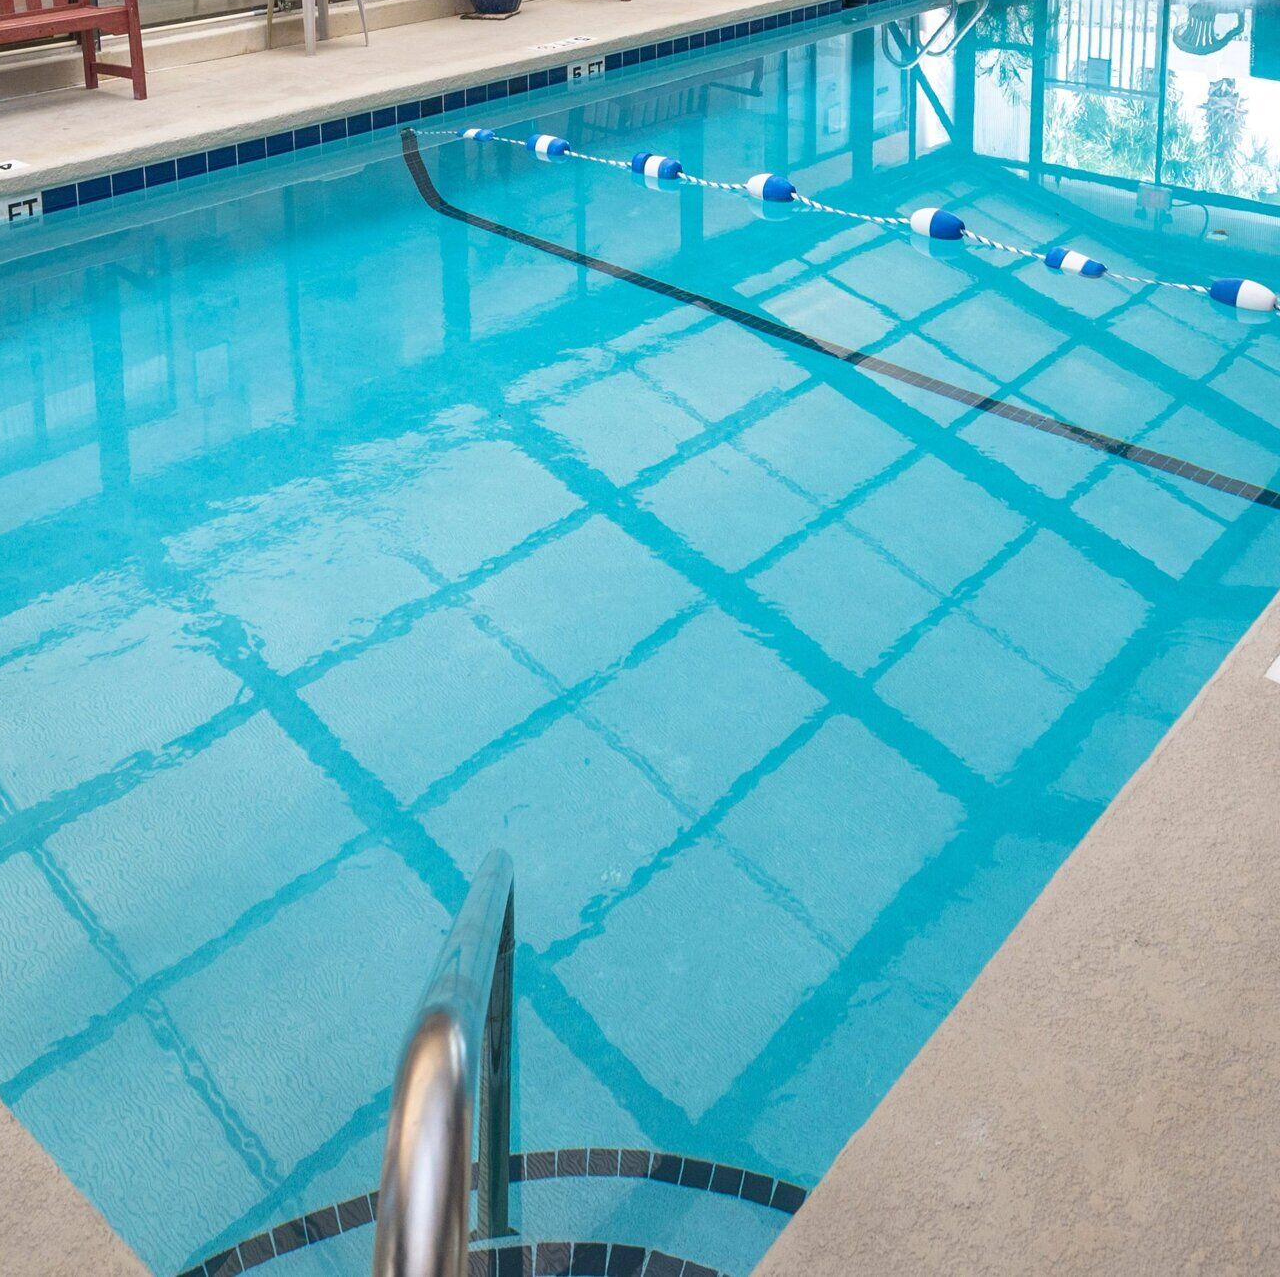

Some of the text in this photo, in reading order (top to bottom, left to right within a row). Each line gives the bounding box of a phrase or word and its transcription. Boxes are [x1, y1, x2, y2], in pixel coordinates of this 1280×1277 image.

[573, 60, 603, 78] 5 FT
[8, 197, 38, 222] FT
